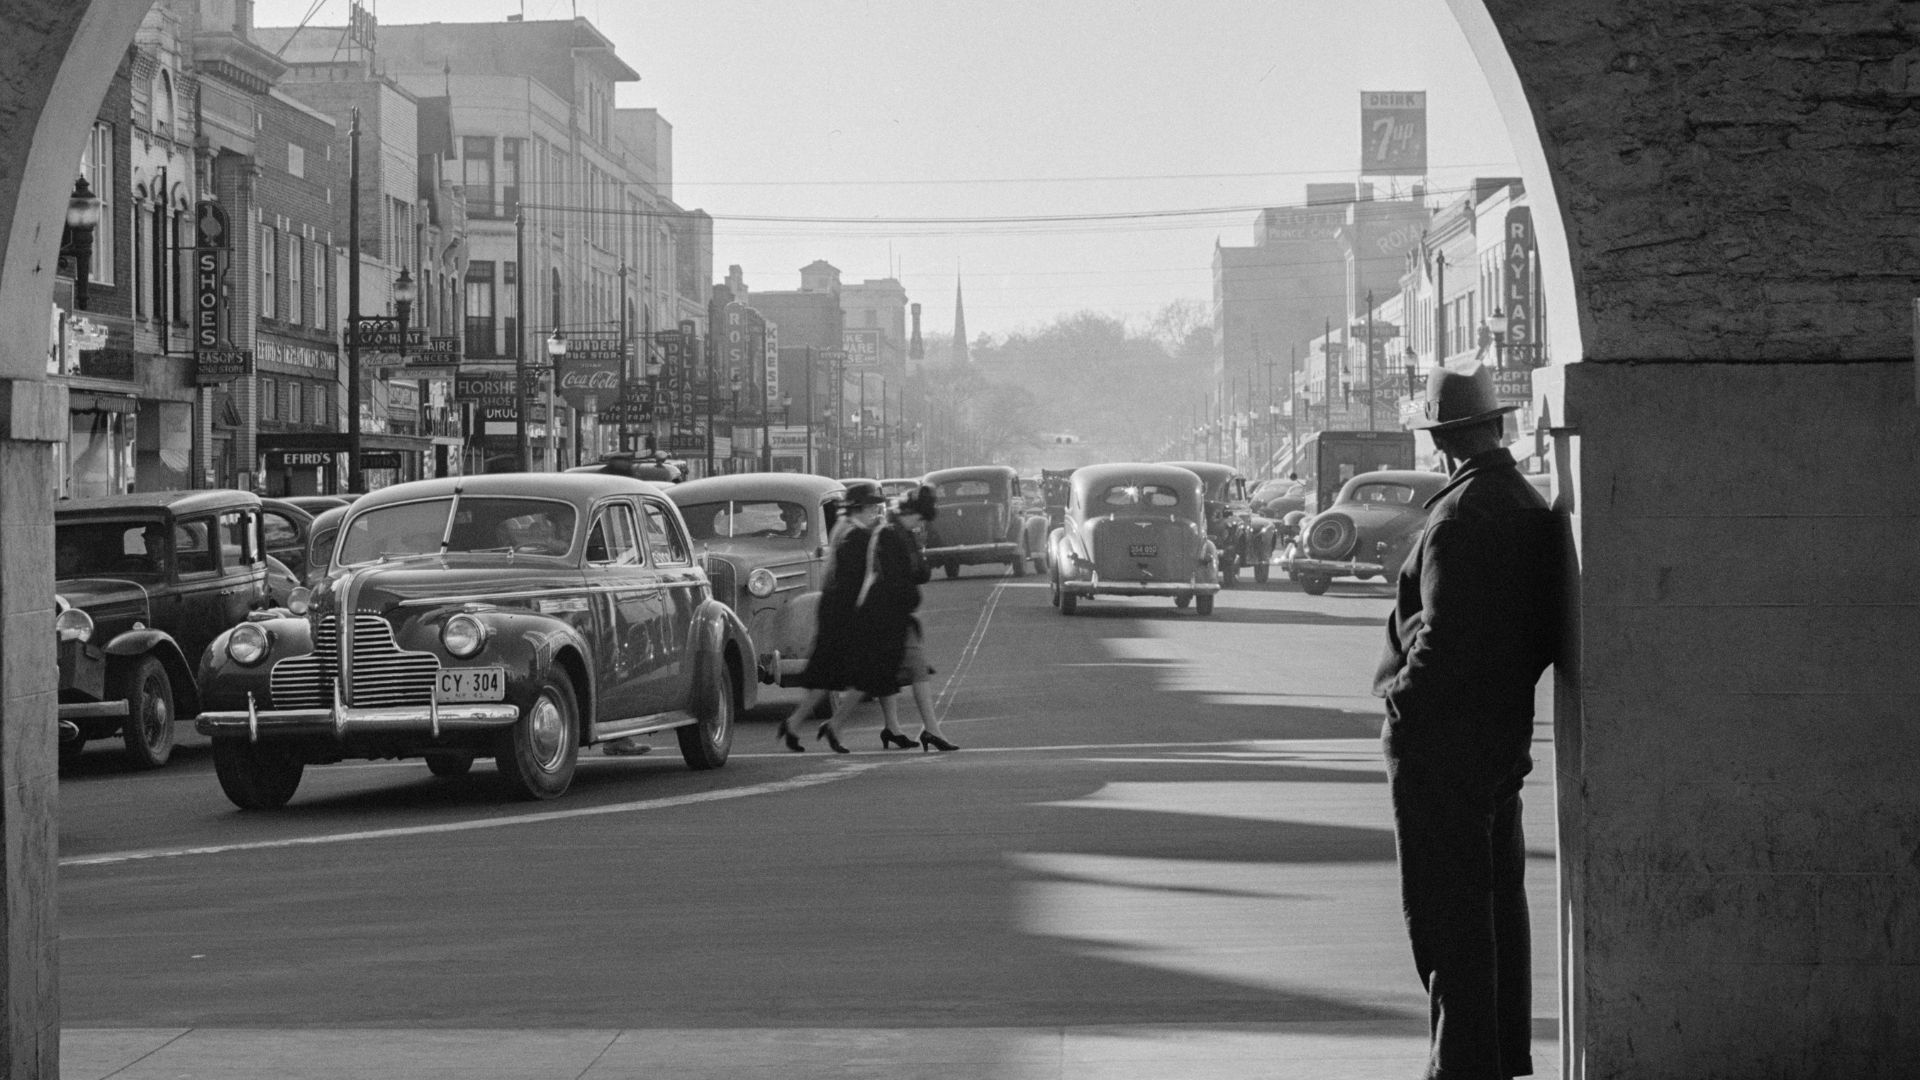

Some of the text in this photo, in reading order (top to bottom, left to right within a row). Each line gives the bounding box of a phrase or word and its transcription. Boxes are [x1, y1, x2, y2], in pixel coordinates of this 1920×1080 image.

[1370, 95, 1415, 106] DRINK
[200, 255, 216, 346] SHOES
[198, 352, 244, 364] EASON'S
[767, 327, 777, 397] KRESS
[682, 324, 692, 426] BILLIARDS
[486, 408, 518, 419] DRUG
[283, 453, 331, 465] EFIRD'S
